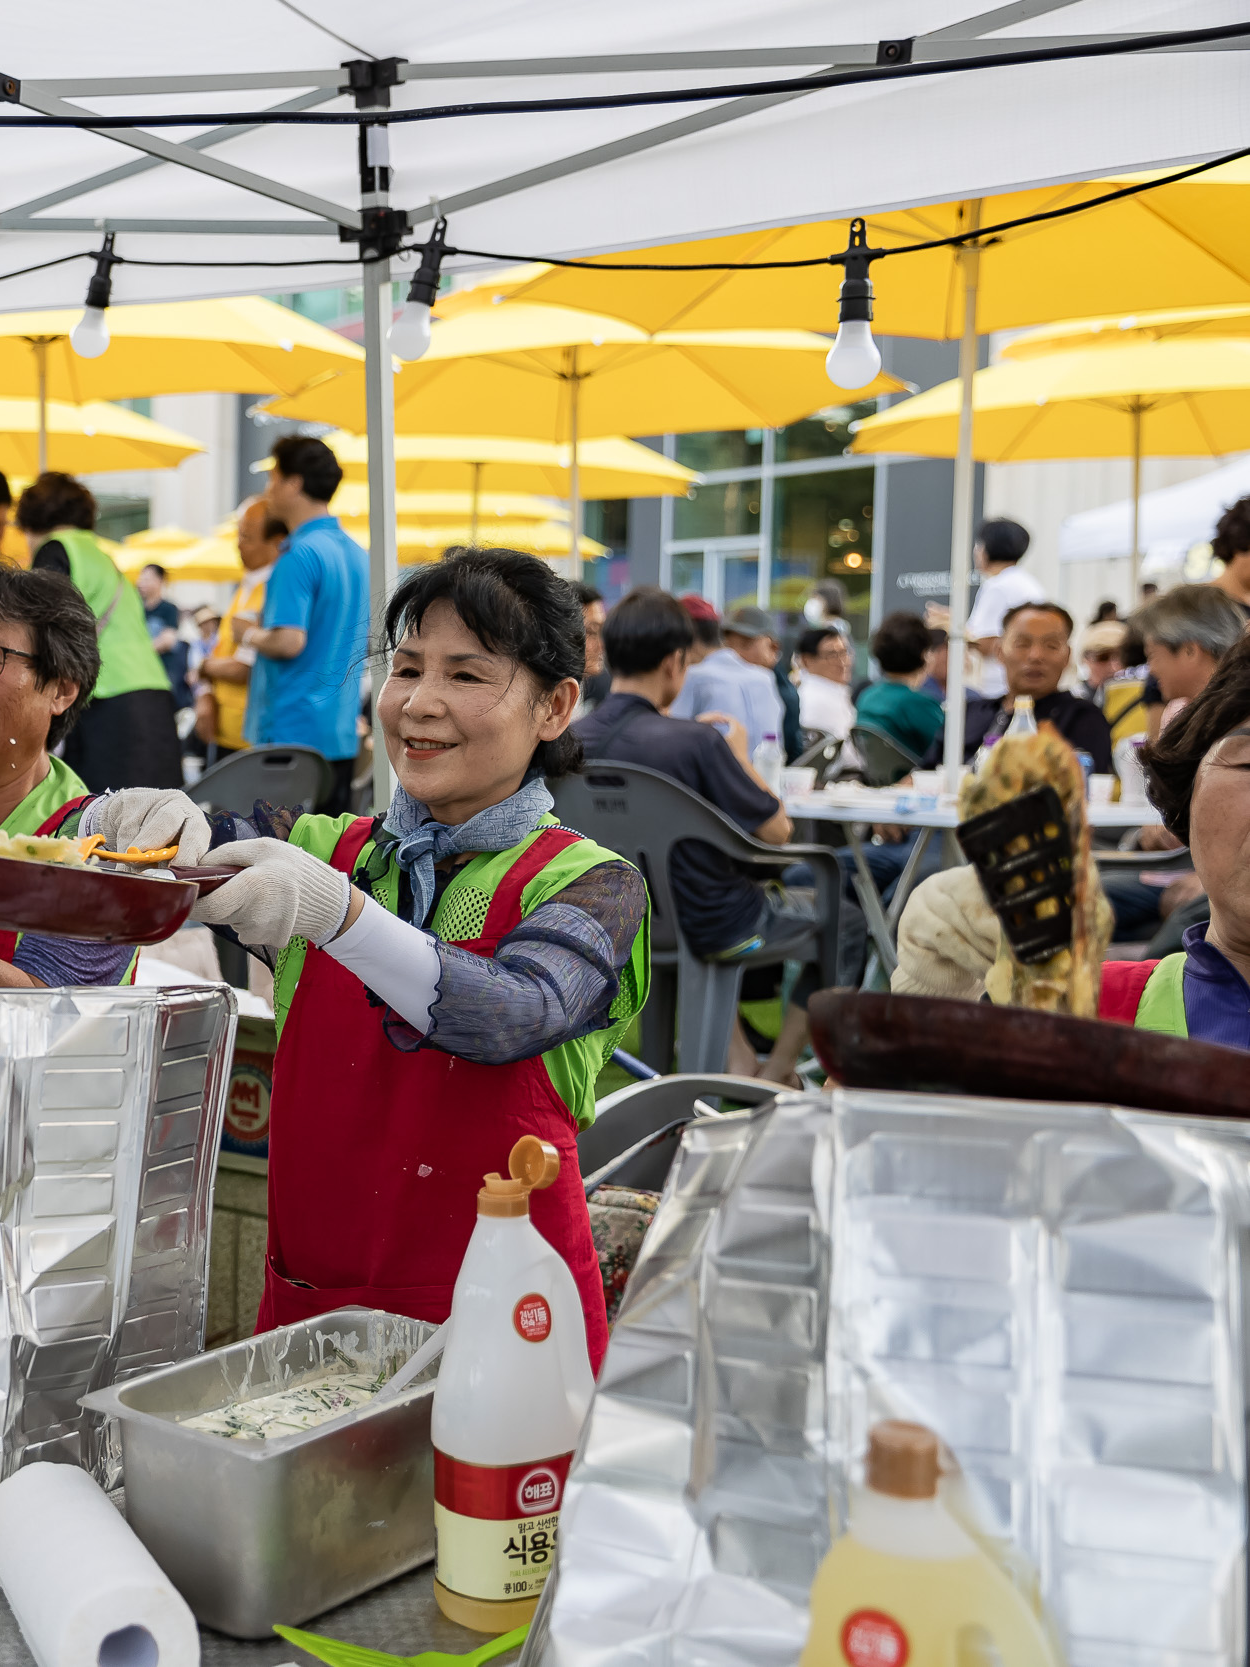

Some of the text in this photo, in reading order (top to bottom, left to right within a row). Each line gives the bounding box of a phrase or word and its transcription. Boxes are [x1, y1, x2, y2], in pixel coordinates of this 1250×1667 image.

[525, 1481, 552, 1499] 해표
[517, 1516, 559, 1534] 맑고 신선한
